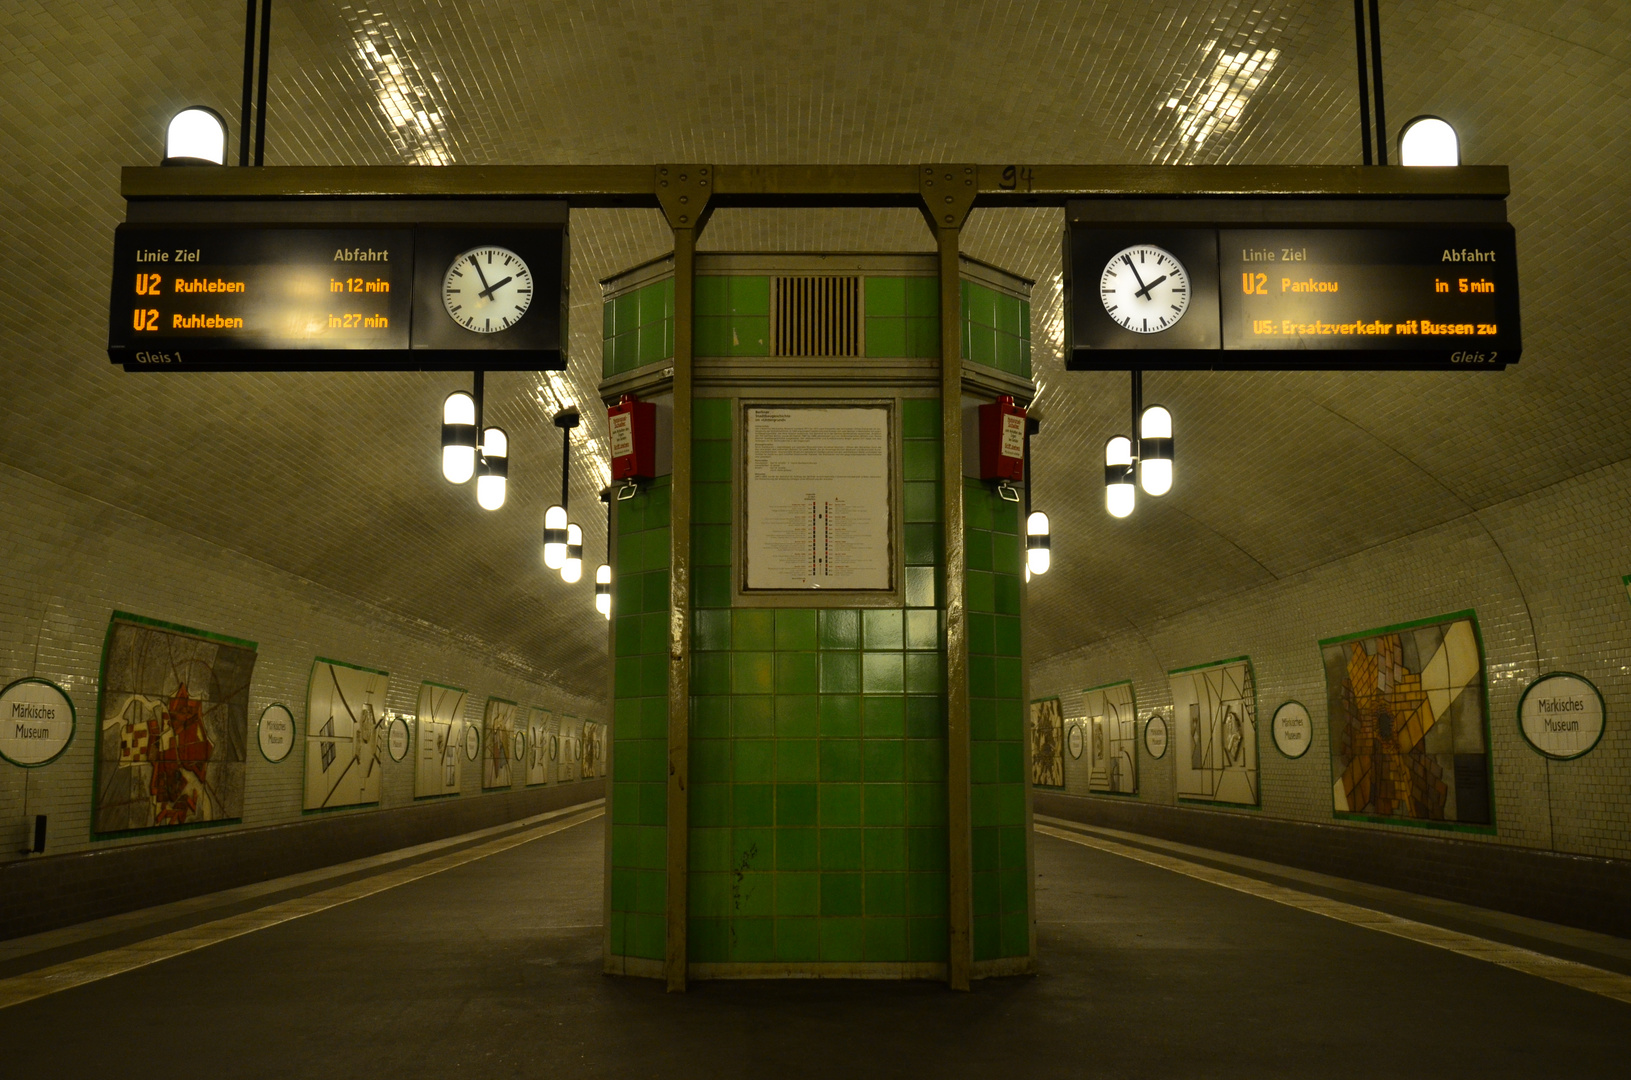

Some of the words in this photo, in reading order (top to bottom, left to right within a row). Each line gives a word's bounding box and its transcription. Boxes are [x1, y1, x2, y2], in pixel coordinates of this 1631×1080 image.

[998, 165, 1035, 192] 94
[136, 249, 169, 262] Linie
[174, 249, 200, 262] Ziel
[333, 248, 389, 262] Abfahrt
[1242, 248, 1276, 262] Linie
[1281, 248, 1306, 262] Ziel
[1441, 248, 1496, 262] Abfahrt
[135, 273, 162, 296] U2
[175, 278, 245, 293] Ruhleben
[330, 278, 344, 293] in
[346, 278, 364, 293] 12
[365, 278, 390, 293] min
[1242, 272, 1268, 295] U2
[1281, 278, 1338, 293] Pankow
[1435, 278, 1449, 293] in
[1458, 278, 1469, 293] 5
[1470, 278, 1495, 293] min
[133, 309, 160, 331] U2
[173, 314, 244, 329] Ruhleben
[328, 313, 342, 329] in
[342, 313, 362, 329] 27
[364, 313, 388, 329] min
[1253, 319, 1278, 335] U5:
[1281, 319, 1393, 335] Ersatzverkehr
[1395, 319, 1418, 335] mit
[1420, 319, 1474, 335] Bussen
[1476, 322, 1497, 335] zw
[135, 351, 172, 365] Gleis
[174, 351, 182, 364] 1
[1450, 351, 1485, 364] Gleis
[1488, 351, 1498, 364] 2
[12, 702, 55, 720] Märkisches
[1538, 697, 1584, 713] Märkisches
[15, 724, 50, 739] Museum
[1544, 719, 1579, 732] Museum
